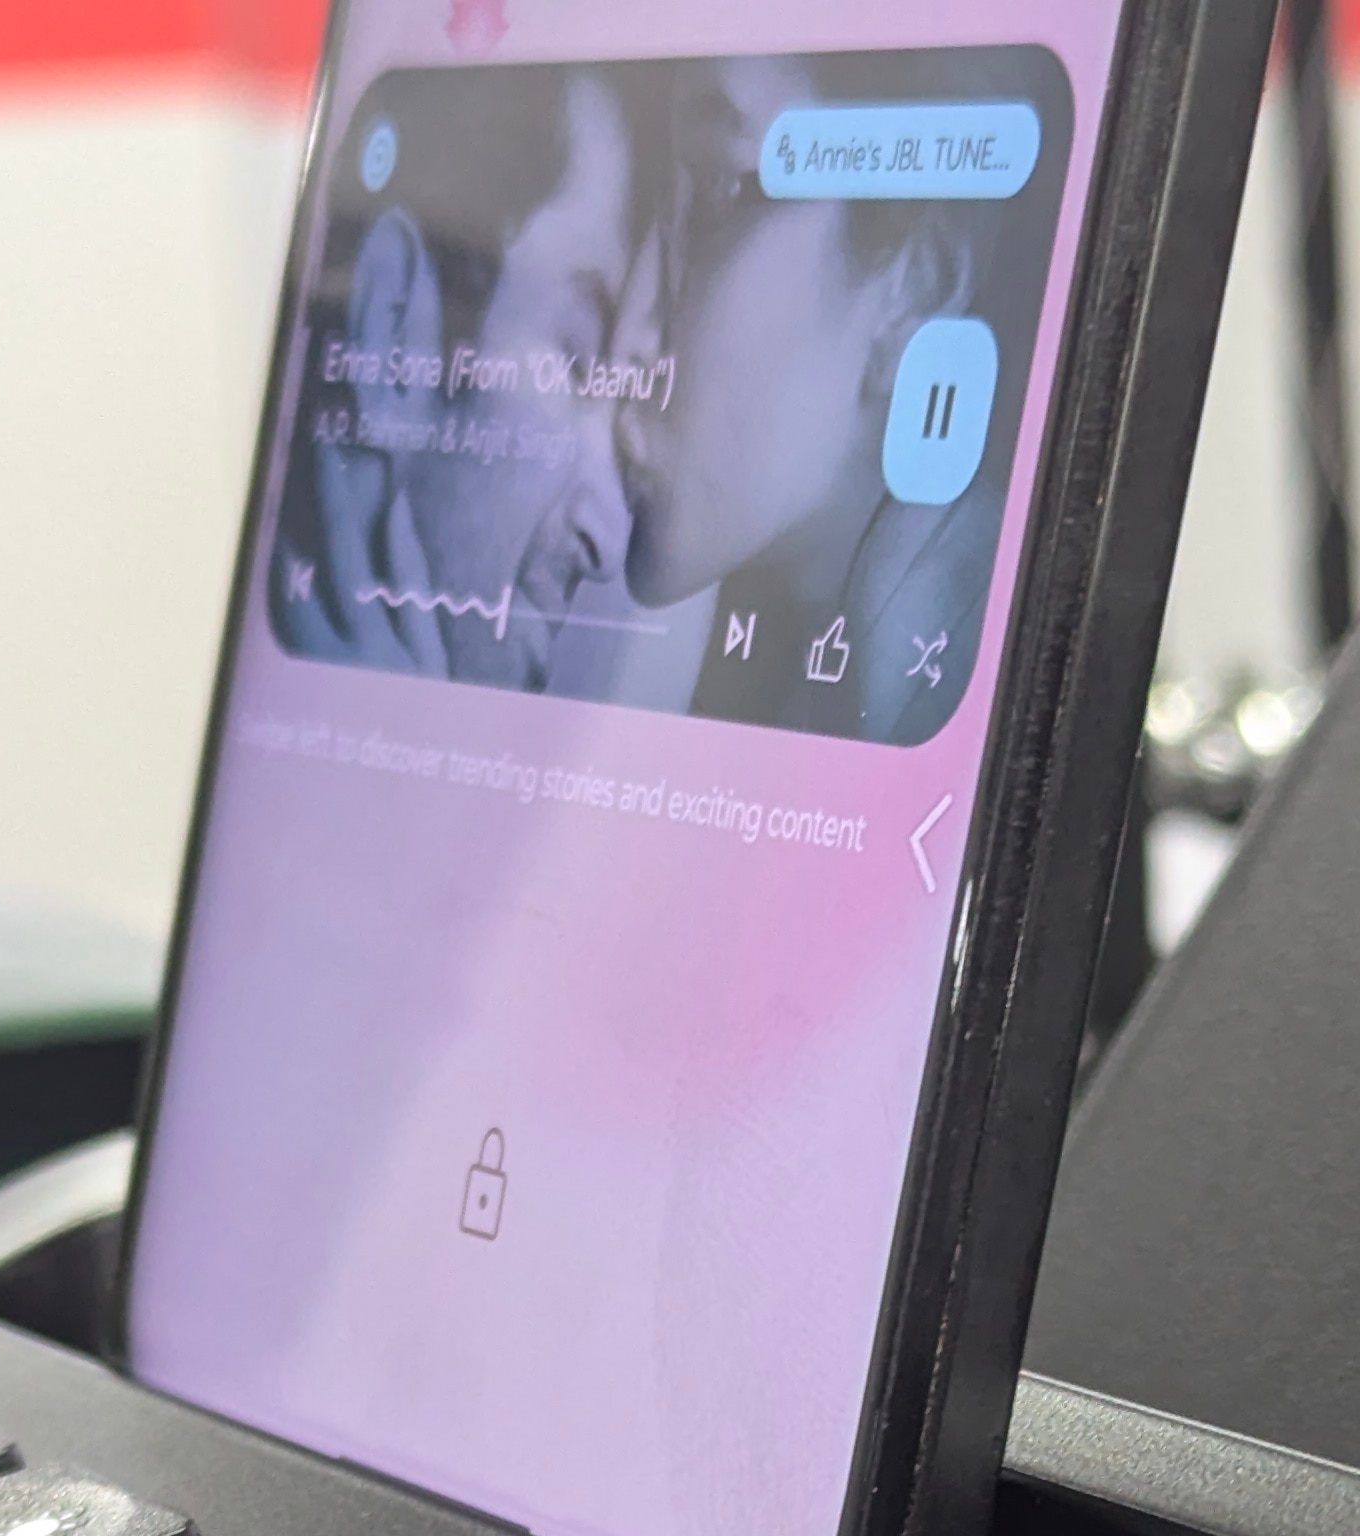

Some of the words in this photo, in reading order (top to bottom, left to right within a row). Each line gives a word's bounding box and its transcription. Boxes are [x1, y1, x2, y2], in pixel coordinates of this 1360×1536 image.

[803, 136, 882, 173] Annie's
[886, 138, 925, 172] JBL
[936, 137, 1010, 172] TUNE...
[386, 347, 441, 388] Sona
[448, 347, 518, 399] (From
[578, 354, 675, 412] Jaanu")
[448, 750, 537, 804] trending
[542, 766, 614, 808] stories
[620, 779, 666, 816] and
[668, 786, 763, 844] exciting
[767, 806, 869, 852] content
